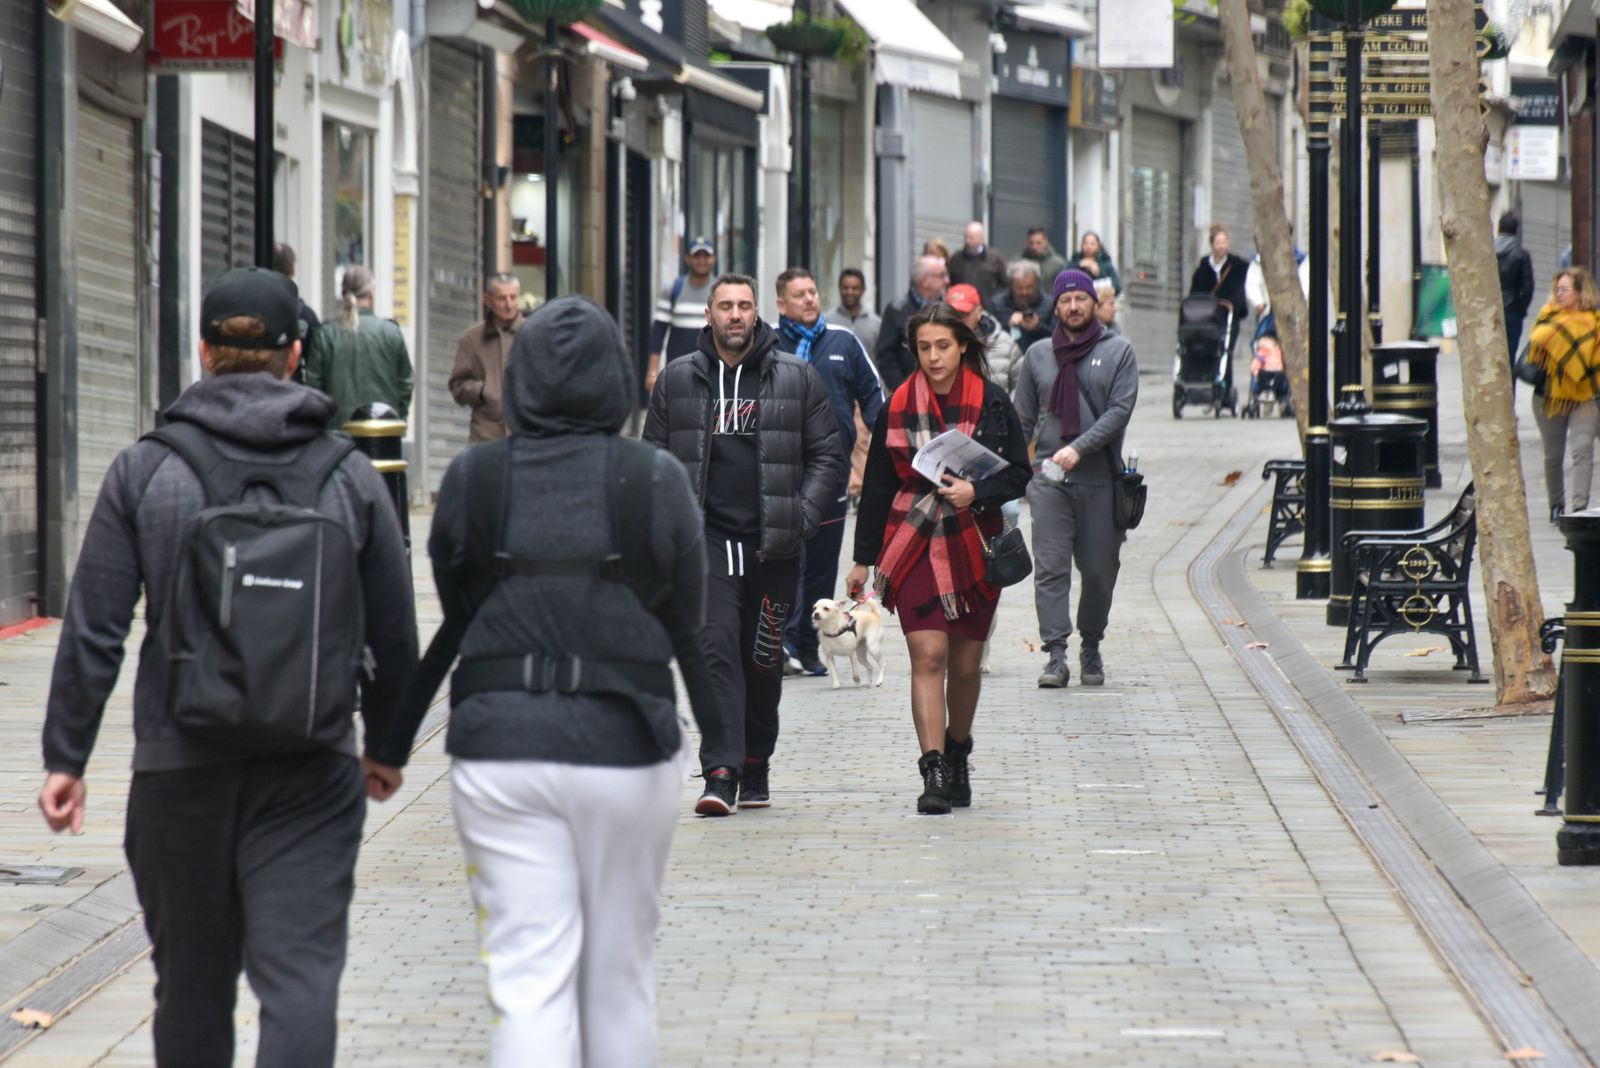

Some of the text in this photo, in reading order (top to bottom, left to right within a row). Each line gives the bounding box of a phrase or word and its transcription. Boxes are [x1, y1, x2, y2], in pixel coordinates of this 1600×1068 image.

[162, 7, 255, 56] Ray-B
[1333, 42, 1381, 52] BEAM
[1332, 103, 1374, 113] ACSS
[1383, 103, 1399, 113] TO
[752, 599, 790, 668] NIKE
